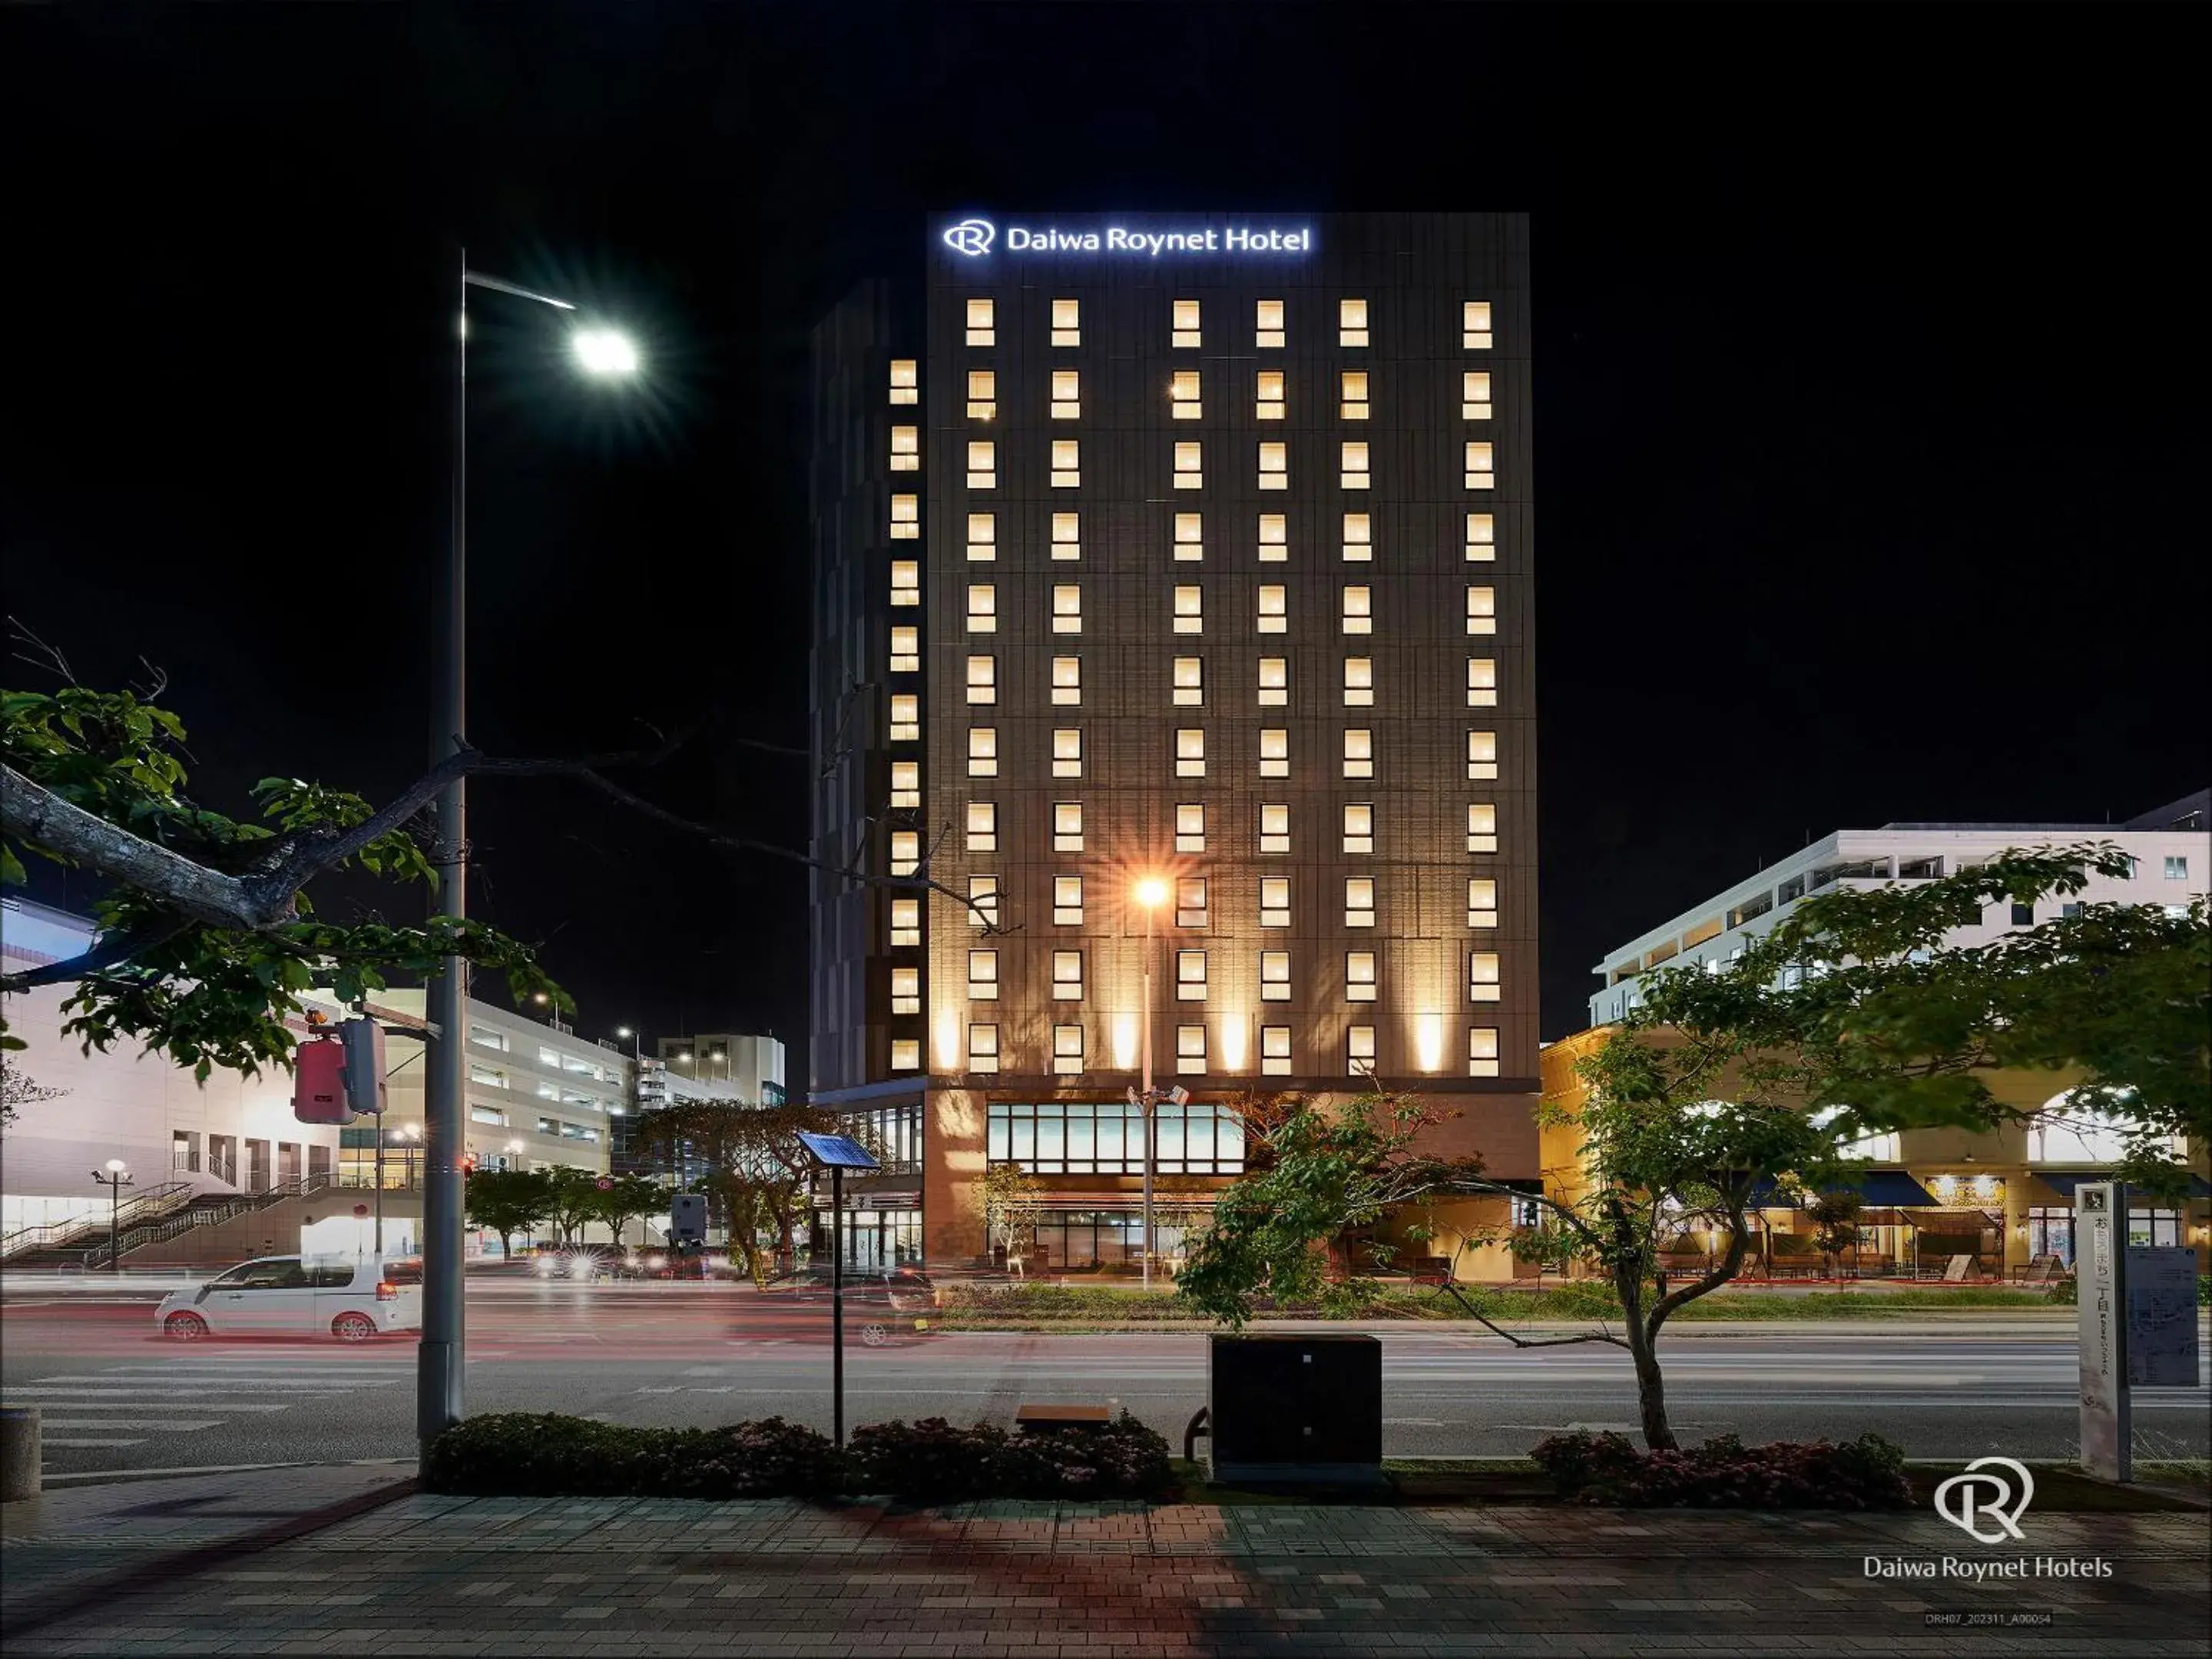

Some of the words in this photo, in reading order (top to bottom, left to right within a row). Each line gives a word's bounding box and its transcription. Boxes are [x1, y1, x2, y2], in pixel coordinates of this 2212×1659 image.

[1008, 228, 1100, 251] Daiwa
[1107, 228, 1218, 256] Roynet
[1227, 228, 1310, 251] Hotel
